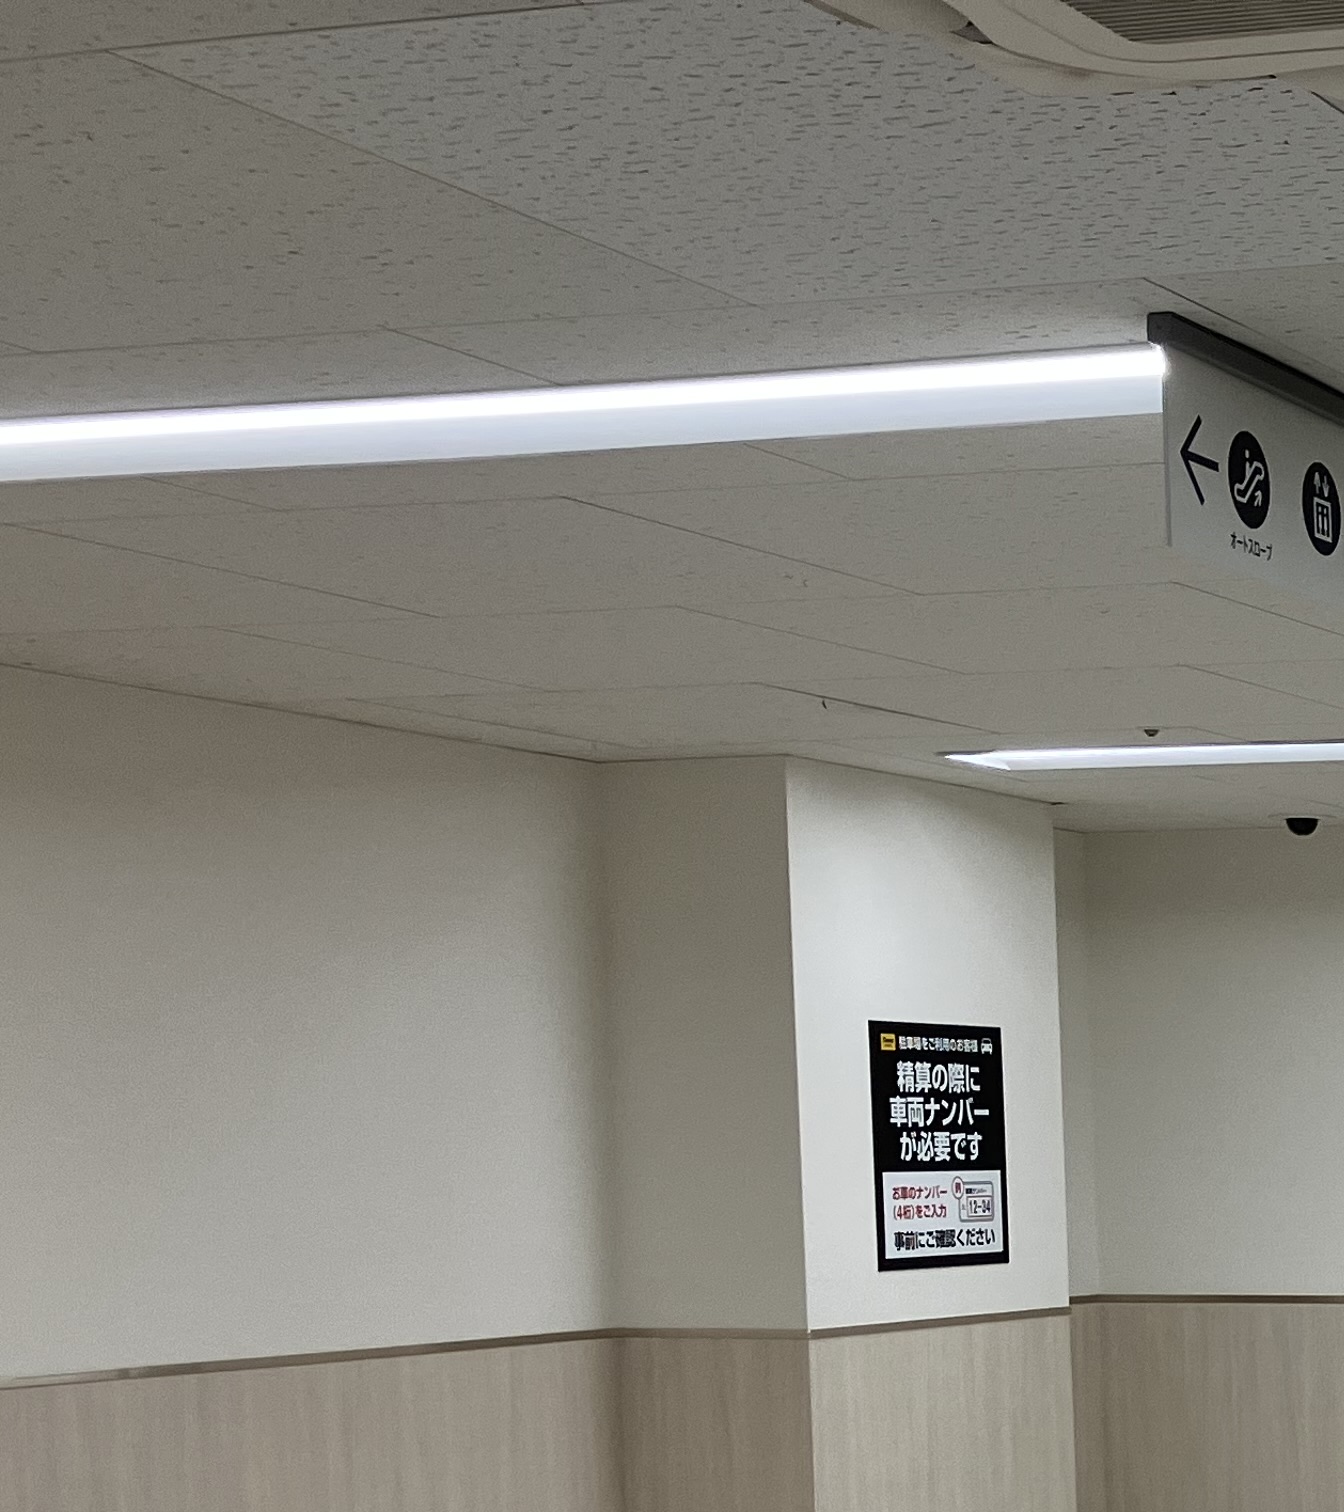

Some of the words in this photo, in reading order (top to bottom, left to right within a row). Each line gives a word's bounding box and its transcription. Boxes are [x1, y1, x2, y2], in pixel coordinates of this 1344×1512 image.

[1230, 531, 1273, 561] オートスロープ
[896, 1061, 981, 1094] 精算の際に
[889, 1096, 989, 1128] 車両ナンバー
[899, 1131, 983, 1162] が必要です
[892, 1183, 948, 1201] お車のナンバー
[892, 1204, 947, 1220] (4桁)をご入力
[893, 1228, 996, 1251] 事前にご確認ください
